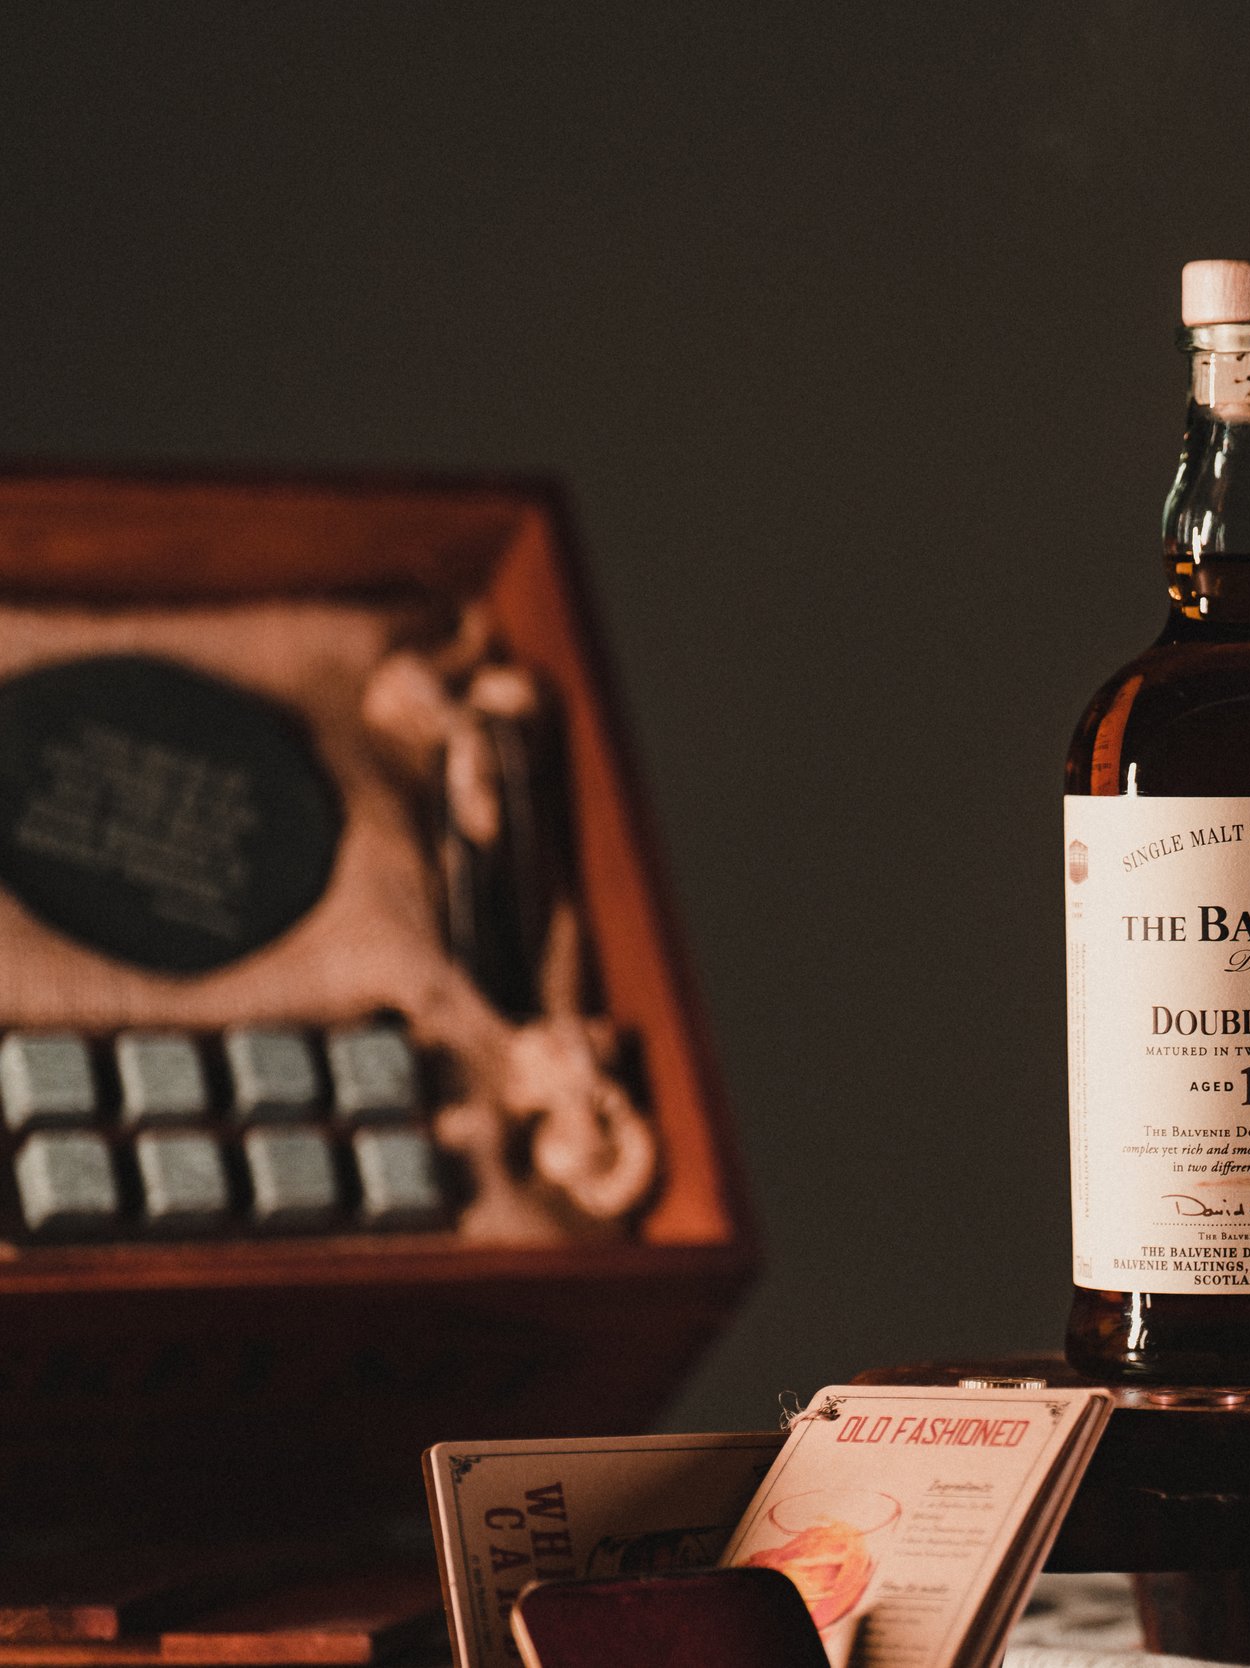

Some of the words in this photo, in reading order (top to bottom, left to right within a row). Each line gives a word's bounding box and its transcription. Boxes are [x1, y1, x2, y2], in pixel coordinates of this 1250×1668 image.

[1122, 834, 1184, 873] SINGLE
[1190, 824, 1244, 848] MALT
[1121, 916, 1187, 942] THE
[1146, 1046, 1208, 1056] MATURED
[1214, 1046, 1229, 1056] IN
[1190, 1081, 1234, 1092] AGED
[1144, 1125, 1168, 1138] THE
[1172, 1125, 1231, 1138] BALVENIE
[1122, 1142, 1159, 1157] complex
[1161, 1147, 1178, 1157] yet
[1181, 1144, 1203, 1155] rich
[1206, 1143, 1229, 1155] and
[1173, 1162, 1184, 1172] in
[1187, 1164, 1207, 1173] two
[1161, 1194, 1245, 1217] David
[1198, 1232, 1218, 1240] THE
[1141, 1246, 1166, 1257] THE
[1170, 1247, 1237, 1258] BALVENIE
[1113, 1259, 1168, 1271] BALVENIE
[1173, 1261, 1249, 1274] MALTINGS,
[837, 1416, 893, 1443] OLD
[890, 1417, 1030, 1447] FASHIONED
